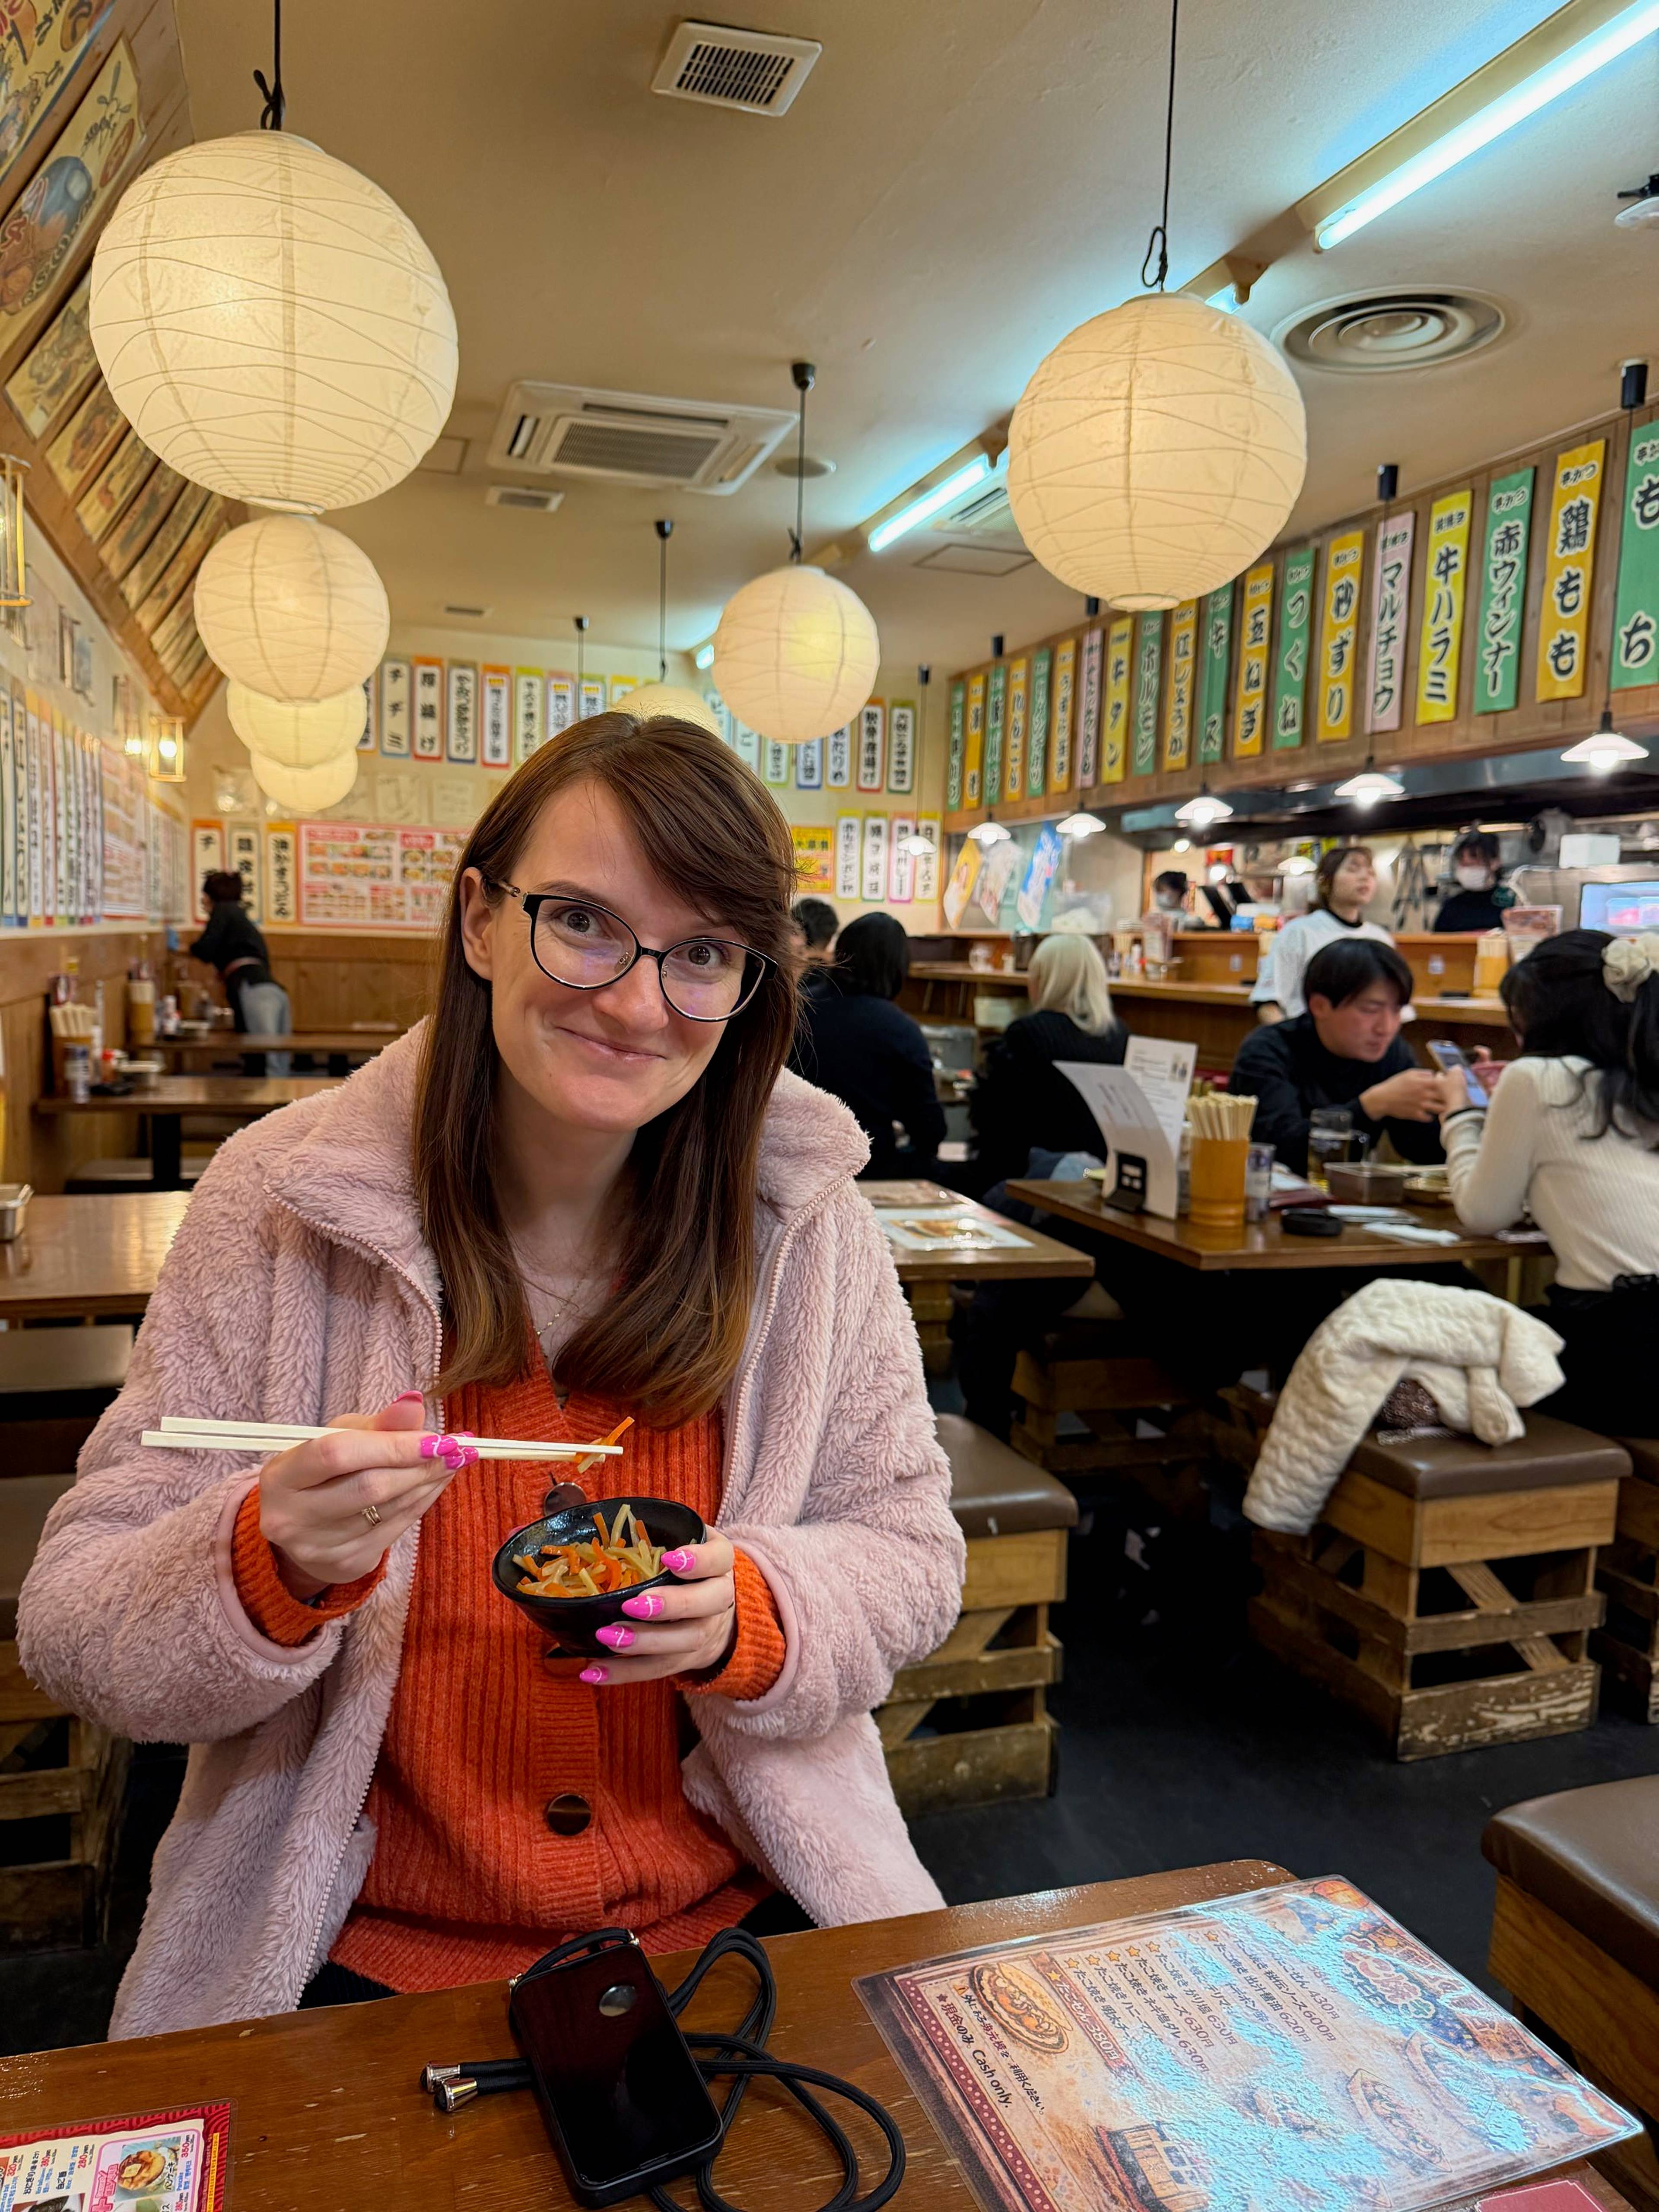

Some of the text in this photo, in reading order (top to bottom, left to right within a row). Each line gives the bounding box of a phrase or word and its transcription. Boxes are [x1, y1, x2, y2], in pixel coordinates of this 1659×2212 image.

[1494, 489, 1526, 511] 串かつ
[1562, 464, 1596, 486] 串かつ
[1487, 524, 1519, 693] 赤ウィンナー
[1551, 499, 1589, 677] 鶏もも
[1625, 480, 1659, 664] もち
[1280, 593, 1305, 732] つくね
[1329, 580, 1354, 722] 砂ずり
[1374, 562, 1403, 714] マルチョウ
[1426, 546, 1458, 702] 牛ハラミ
[1055, 1981, 1122, 2060] たこせん 380円
[1073, 1969, 1108, 2003] たこ焼き
[1093, 1966, 1129, 2000] たこ焼き
[1113, 1962, 1212, 2072] たこ焼き ネギ塩ダレ 630円
[1133, 1958, 1217, 2047] たこ焼き チーズ 630円
[1155, 1953, 1191, 1987] たこ焼き
[1182, 1988, 1214, 2014] がり塩
[1212, 1943, 1315, 2042] たこ焼き 出汁醤油 620円
[1262, 1970, 1309, 2010] 秘伝ソース
[1301, 2010, 1339, 2041] 600円
[1306, 1989, 1344, 2019] 430円
[941, 2002, 1012, 2108] 現金のみ。 Cash only.
[78, 2144, 89, 2169] 280yen
[164, 2161, 175, 2190] パンケーキ
[181, 2134, 191, 2158] 350yen
